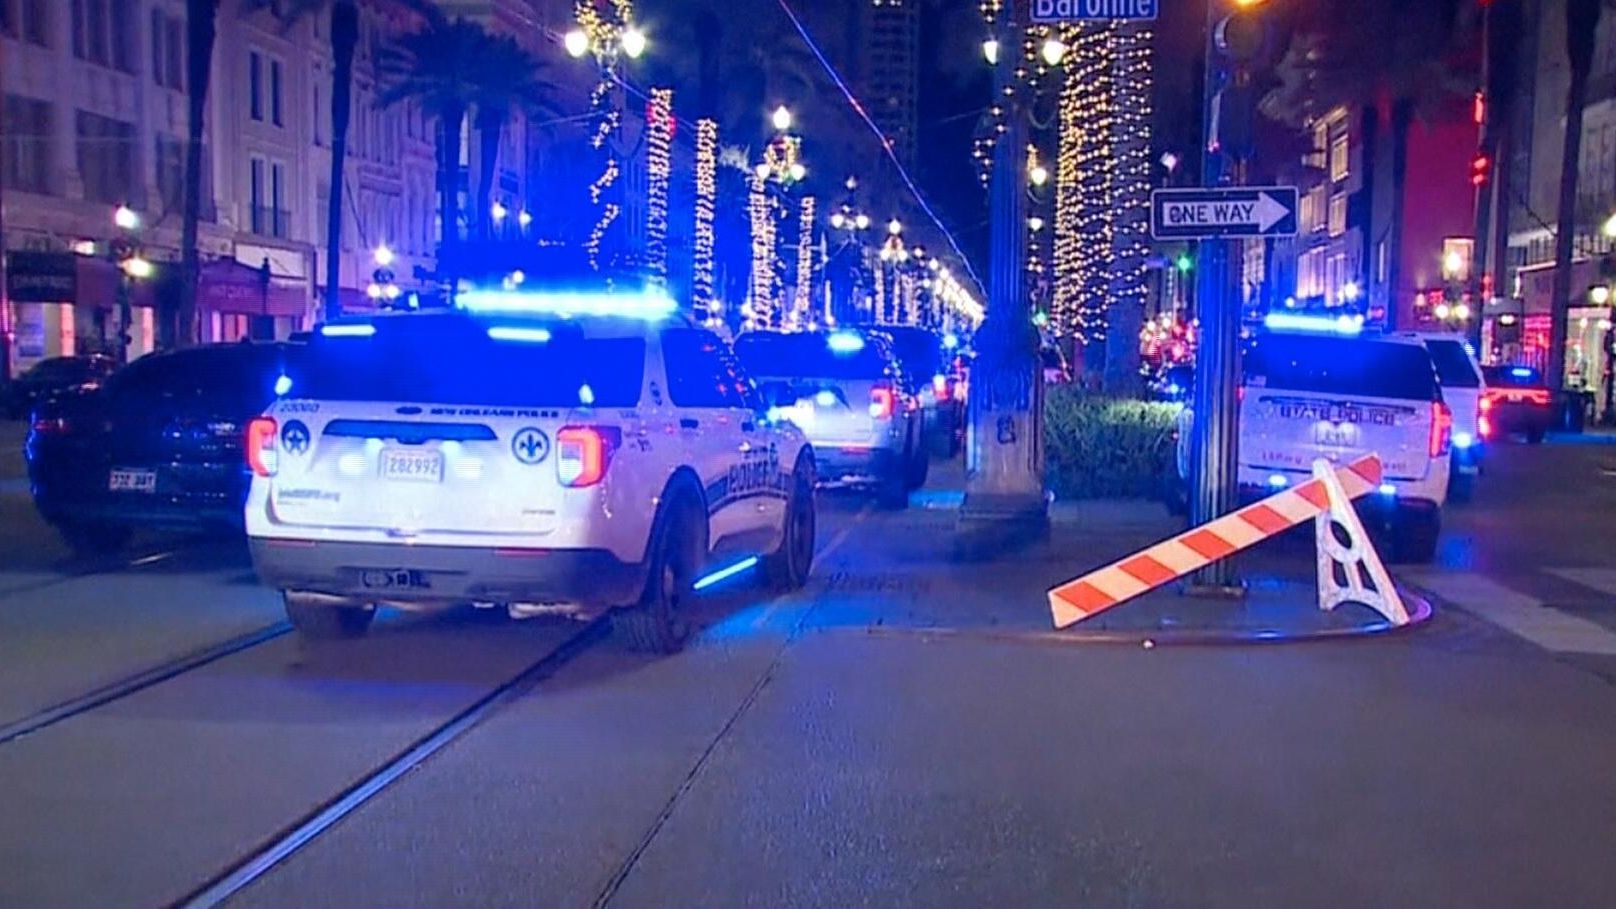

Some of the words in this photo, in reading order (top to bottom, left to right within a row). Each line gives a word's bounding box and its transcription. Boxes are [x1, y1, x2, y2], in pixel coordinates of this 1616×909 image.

[1037, 0, 1149, 16] Baronne
[1169, 205, 1208, 223] ONE
[1213, 203, 1254, 222] WAY
